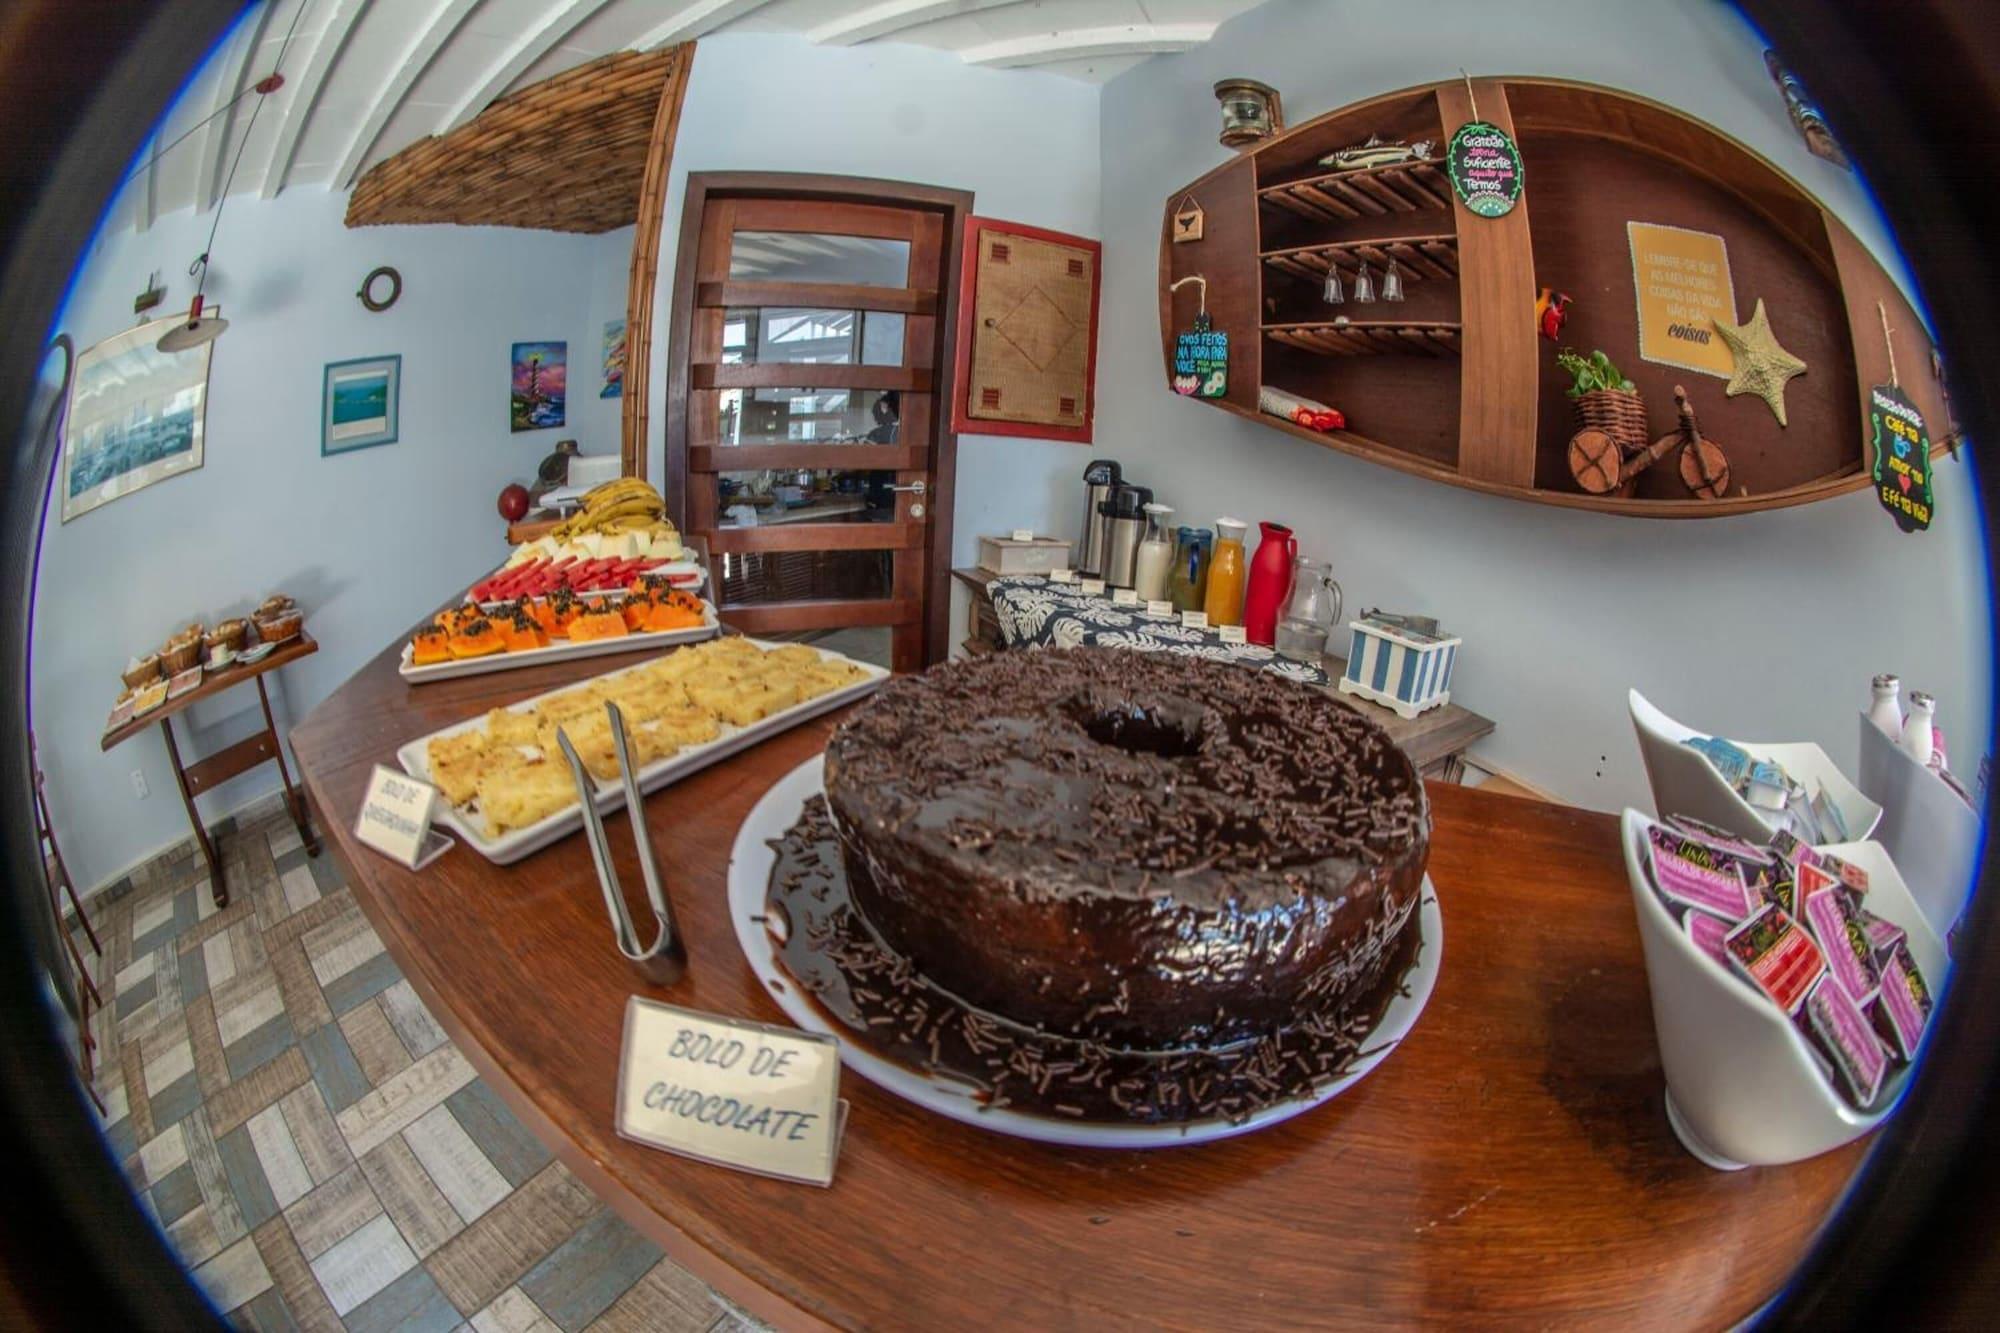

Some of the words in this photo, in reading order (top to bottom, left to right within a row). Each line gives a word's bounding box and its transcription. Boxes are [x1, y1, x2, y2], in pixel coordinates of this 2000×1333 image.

[1462, 178, 1502, 191] Temos
[1180, 333, 1200, 346] OVOS
[1668, 322, 1712, 345] coisas
[668, 1028, 745, 1070] BOLO
[748, 1046, 799, 1078] DE
[643, 1080, 820, 1141] CHOCOLATE
